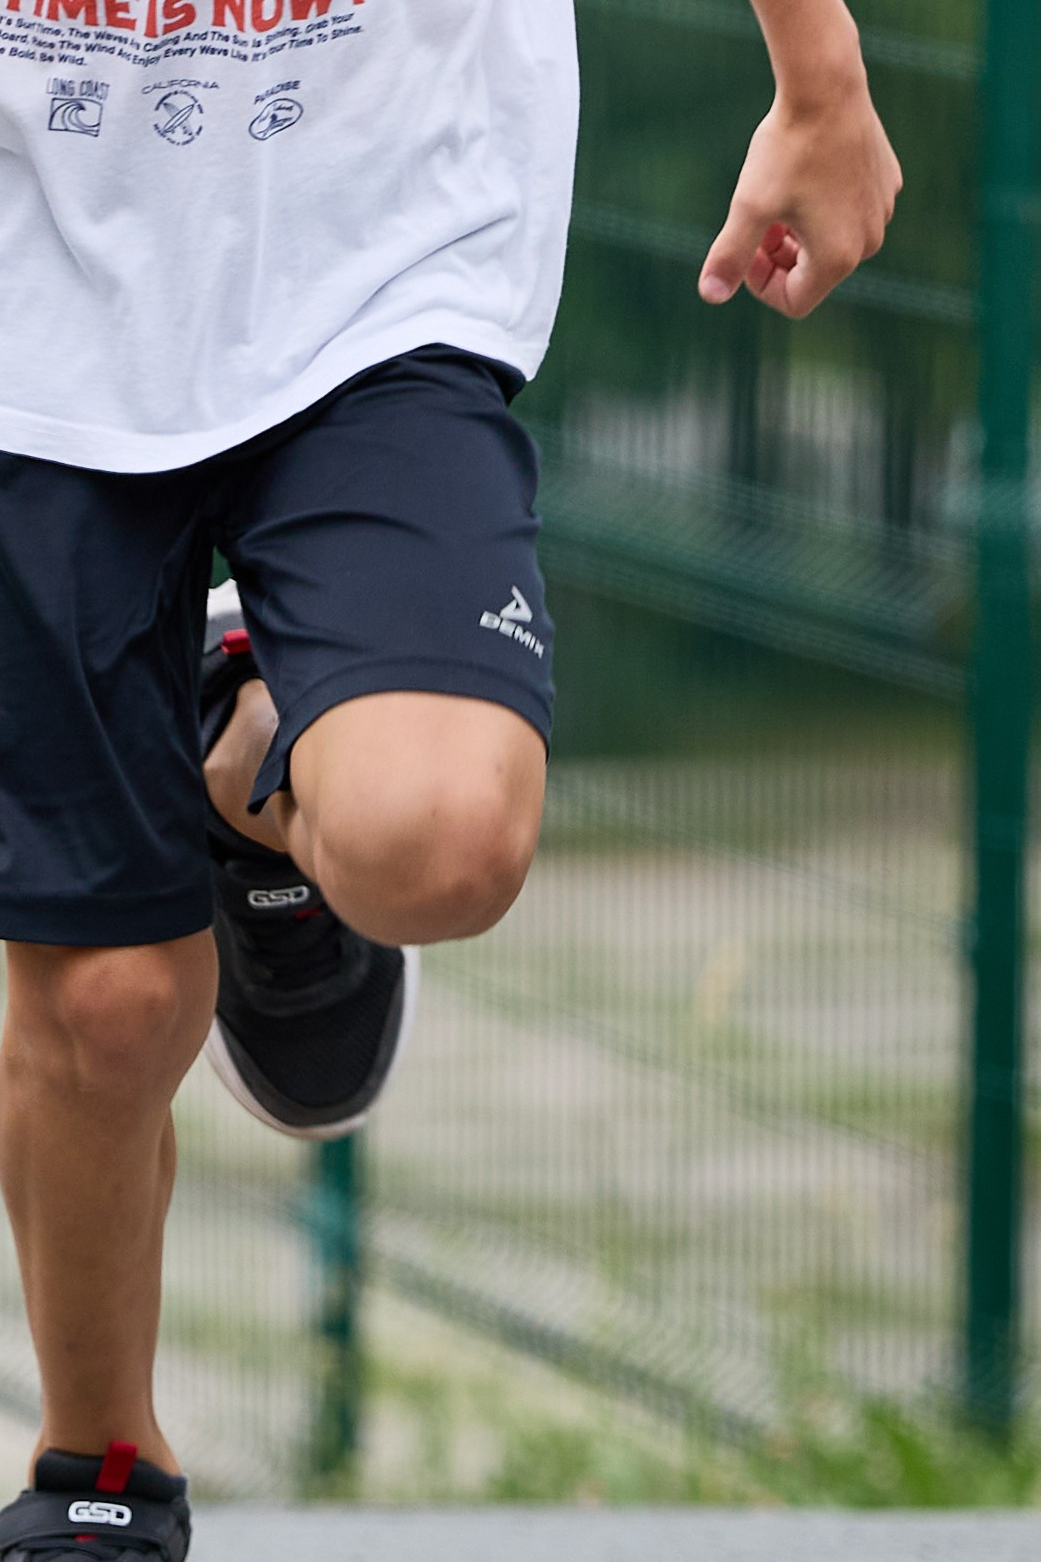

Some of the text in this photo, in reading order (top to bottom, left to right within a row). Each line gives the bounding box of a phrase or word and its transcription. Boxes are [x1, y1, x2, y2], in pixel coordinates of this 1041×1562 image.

[58, 39, 82, 52] The
[84, 42, 116, 55] Wind
[163, 47, 197, 59] Every
[199, 44, 229, 57] Wave
[288, 37, 314, 50] Time
[316, 32, 328, 44] To
[68, 26, 90, 40] The
[183, 31, 208, 42] And
[210, 30, 230, 43] The
[39, 52, 55, 63] Be
[46, 77, 76, 97] LONG
[247, 884, 310, 909] GSD
[67, 1500, 133, 1528] GSD
